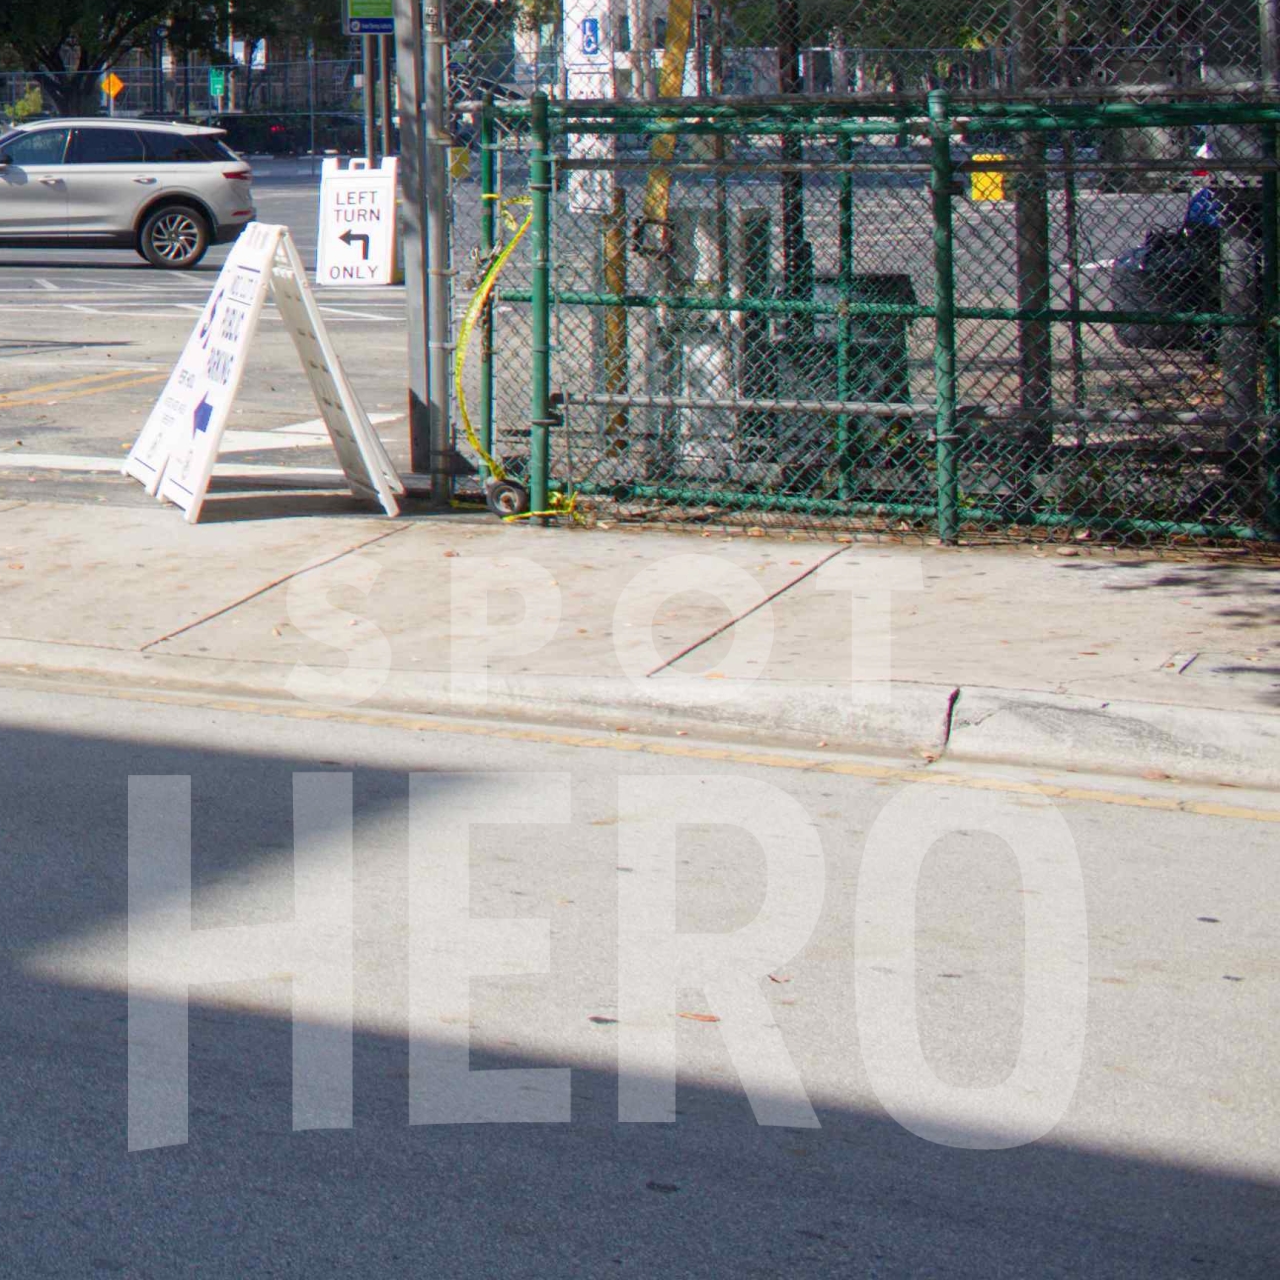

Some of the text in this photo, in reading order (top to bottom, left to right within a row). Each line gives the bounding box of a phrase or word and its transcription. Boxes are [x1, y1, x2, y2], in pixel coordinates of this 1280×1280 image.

[336, 190, 378, 205] LEFT
[334, 208, 380, 222] TURN
[330, 265, 378, 280] ONLY
